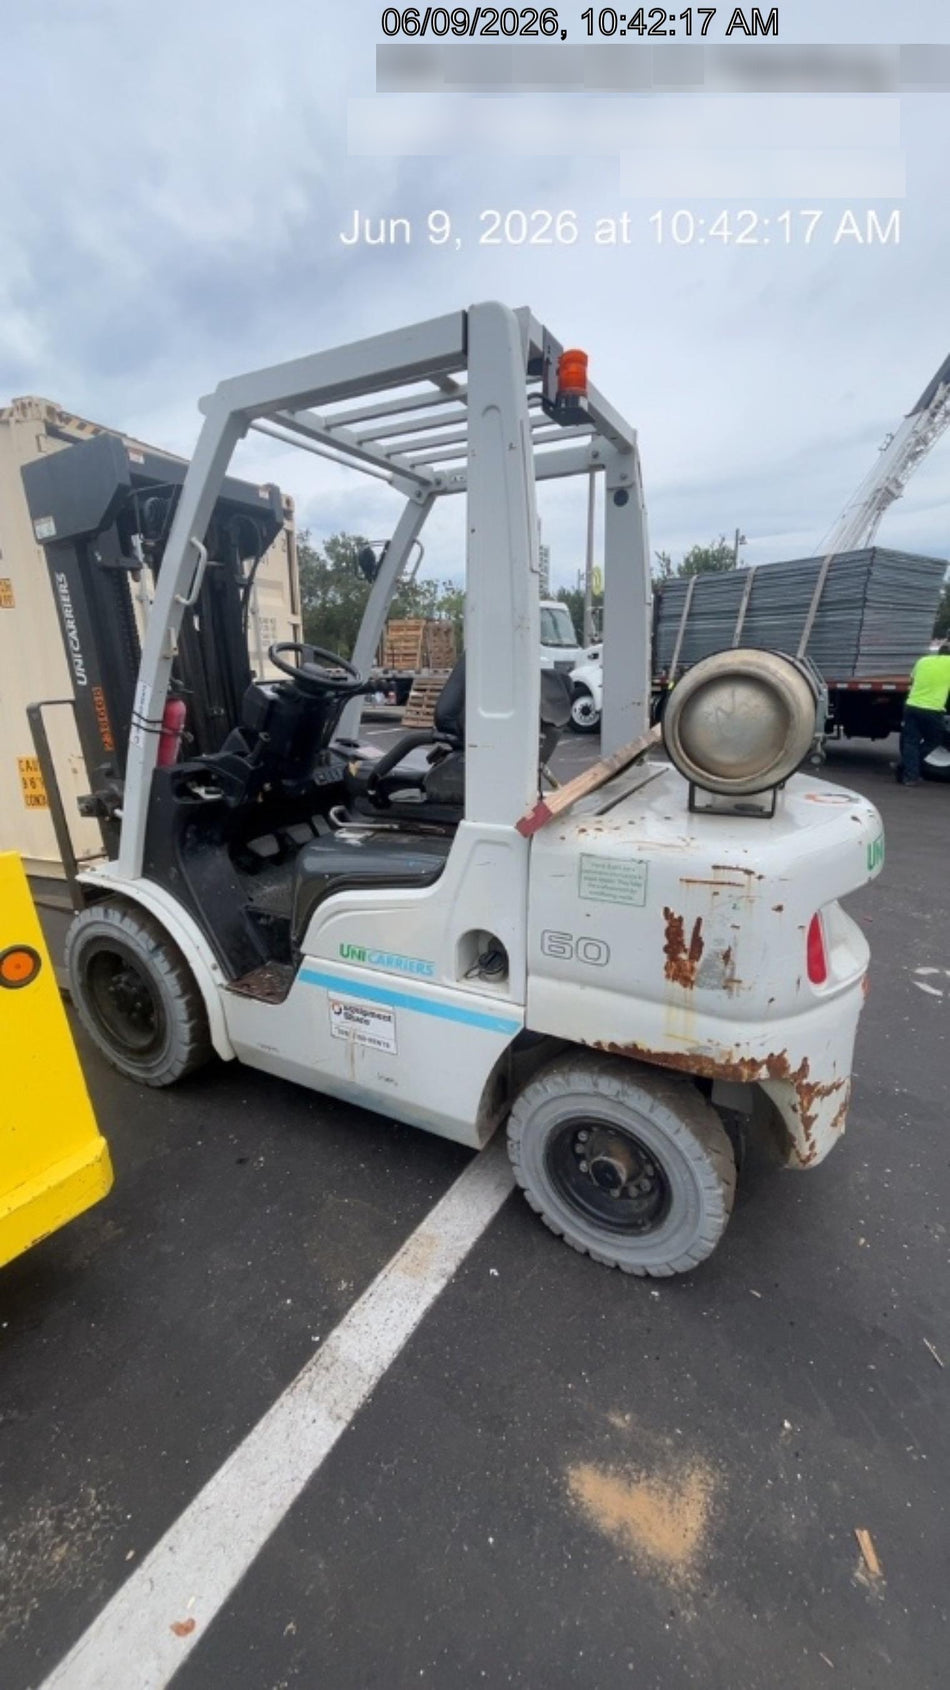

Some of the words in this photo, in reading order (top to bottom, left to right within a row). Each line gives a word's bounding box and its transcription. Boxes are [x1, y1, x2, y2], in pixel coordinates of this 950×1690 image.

[54, 571, 87, 687] UNICARRIERS
[338, 943, 435, 977] UNICARRIERS
[540, 929, 611, 967] 60
